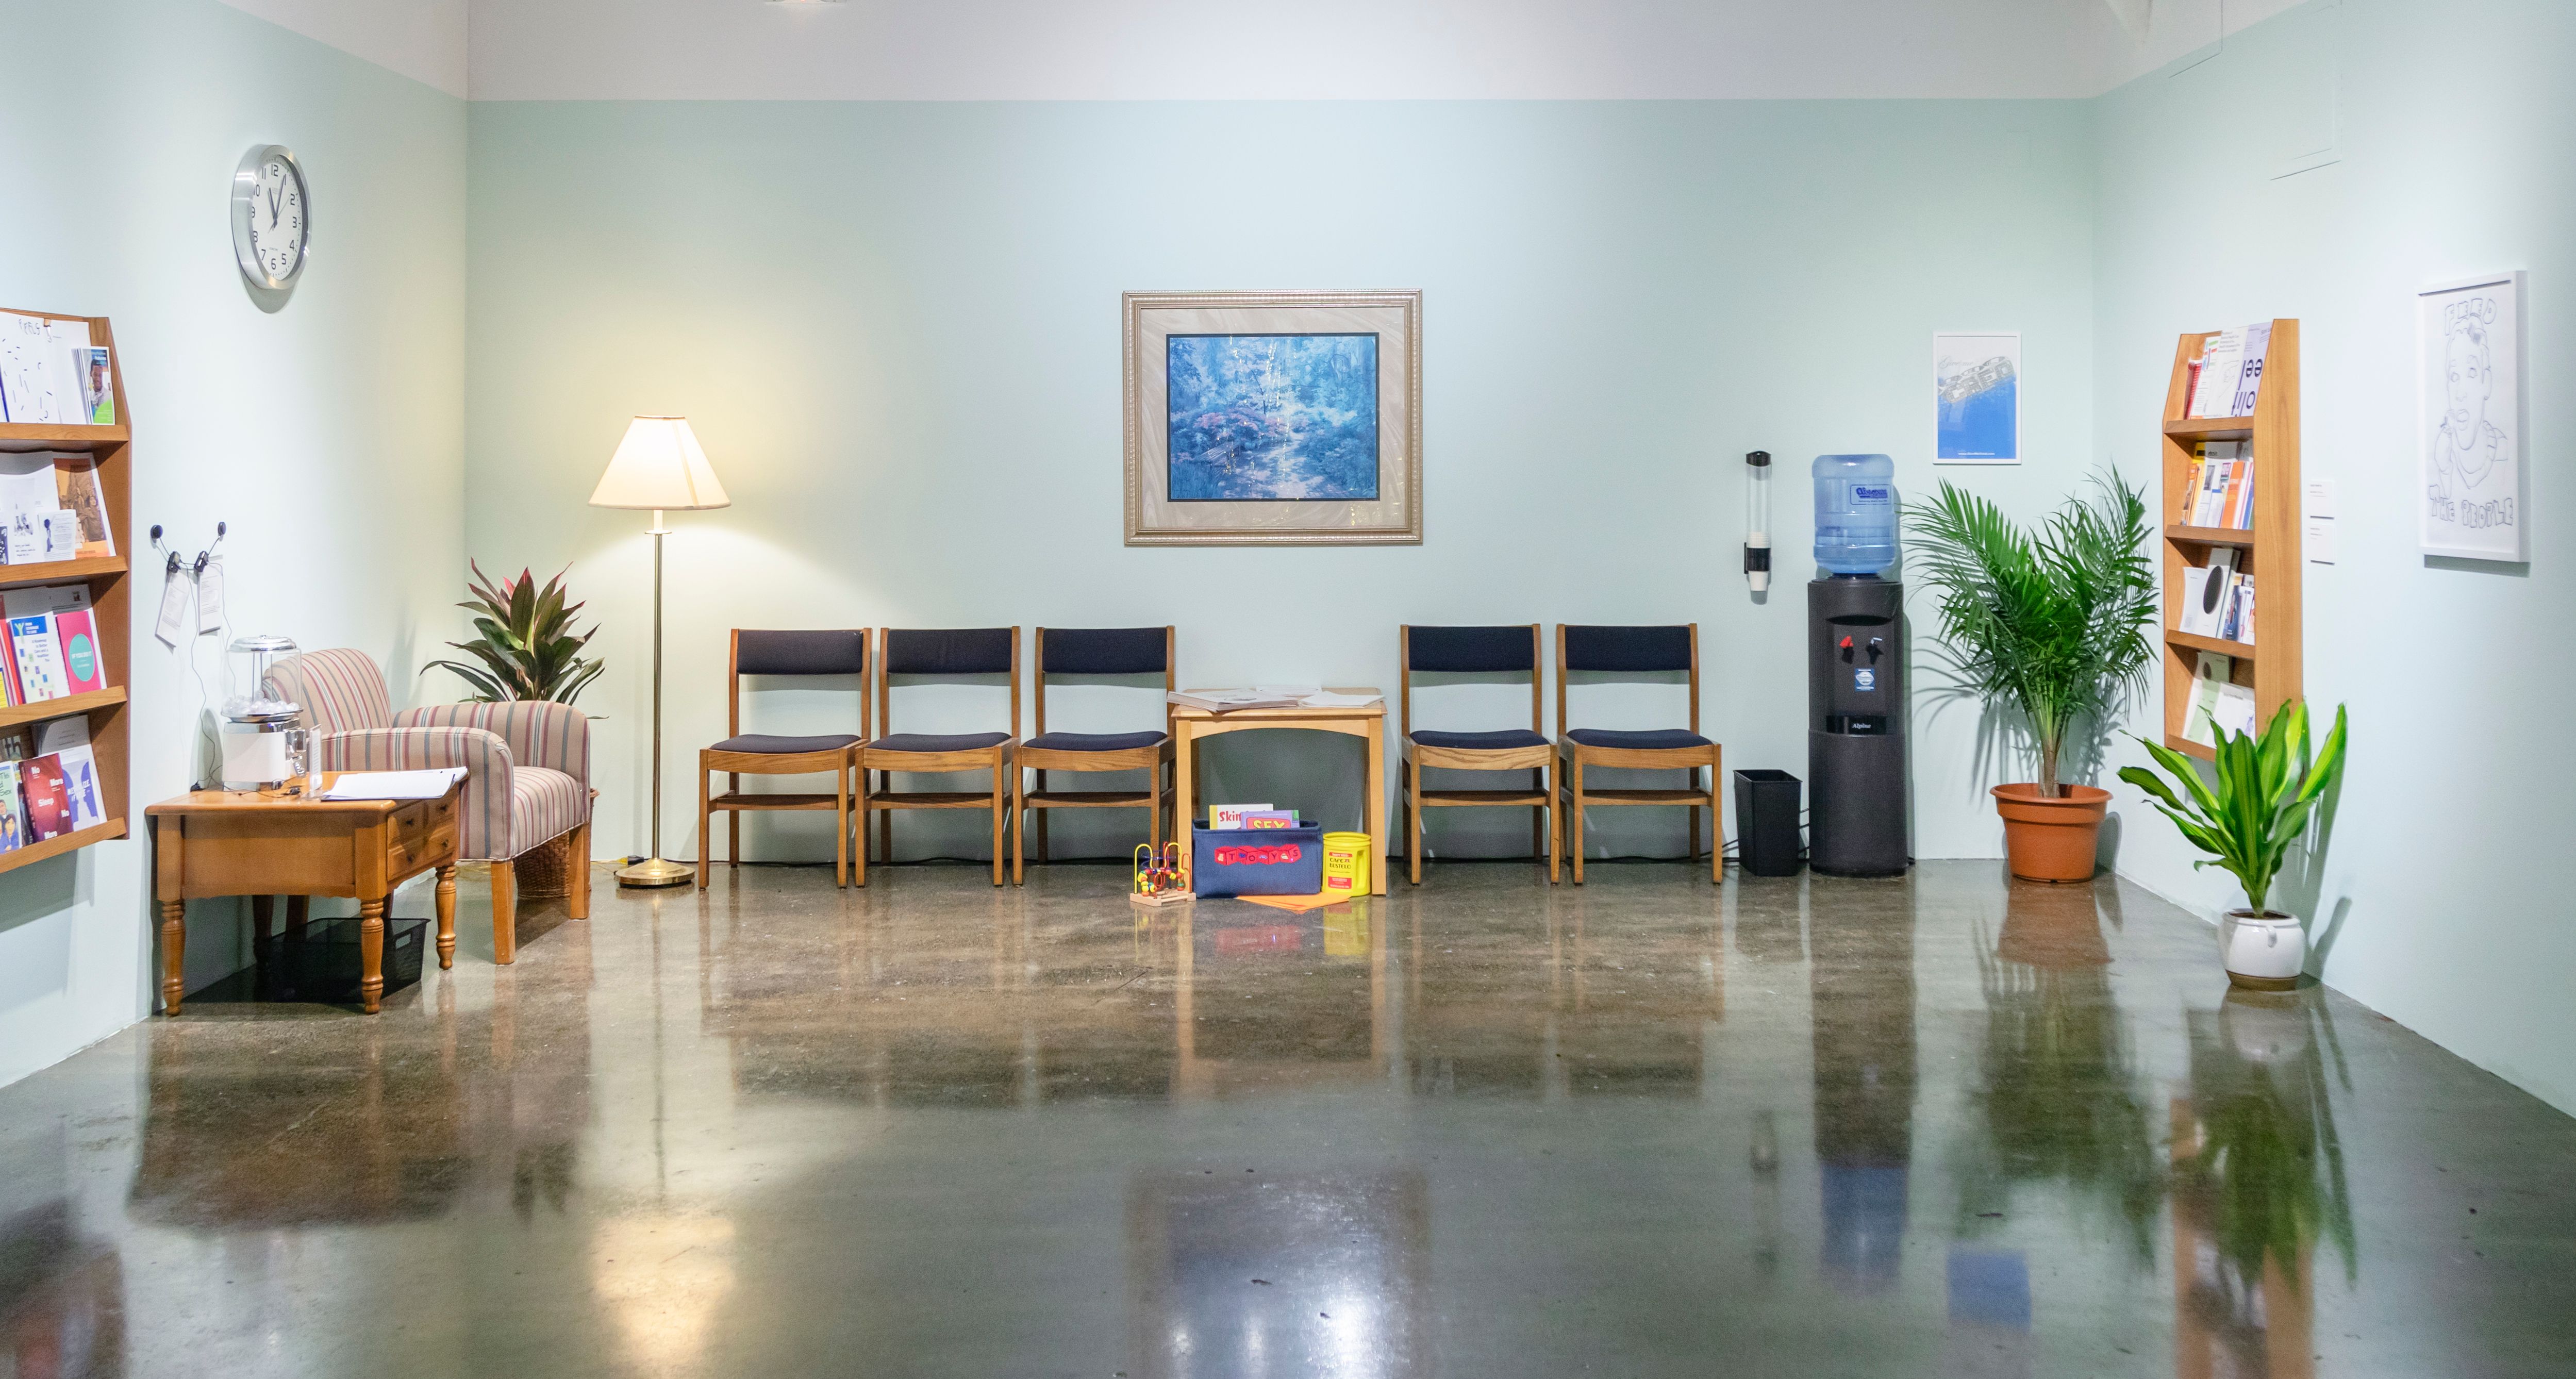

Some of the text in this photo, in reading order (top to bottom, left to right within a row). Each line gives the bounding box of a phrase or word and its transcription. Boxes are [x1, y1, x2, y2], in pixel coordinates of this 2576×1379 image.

[262, 168, 267, 179] 11
[271, 164, 278, 177] 12
[290, 194, 295, 205] 2
[292, 217, 297, 228] 3
[289, 240, 294, 251] 4
[261, 249, 266, 261] 7
[281, 253, 287, 265] 5
[271, 258, 276, 270] 6
[2445, 297, 2497, 336] FEED
[2429, 484, 2513, 528] THE PEOPLE
[31, 766, 40, 775] No
[49, 778, 63, 787] More
[38, 798, 54, 807] Sleep
[61, 809, 70, 818] No
[1219, 810, 1241, 822] Skin
[1253, 820, 1285, 829] SEX
[44, 830, 58, 840] More
